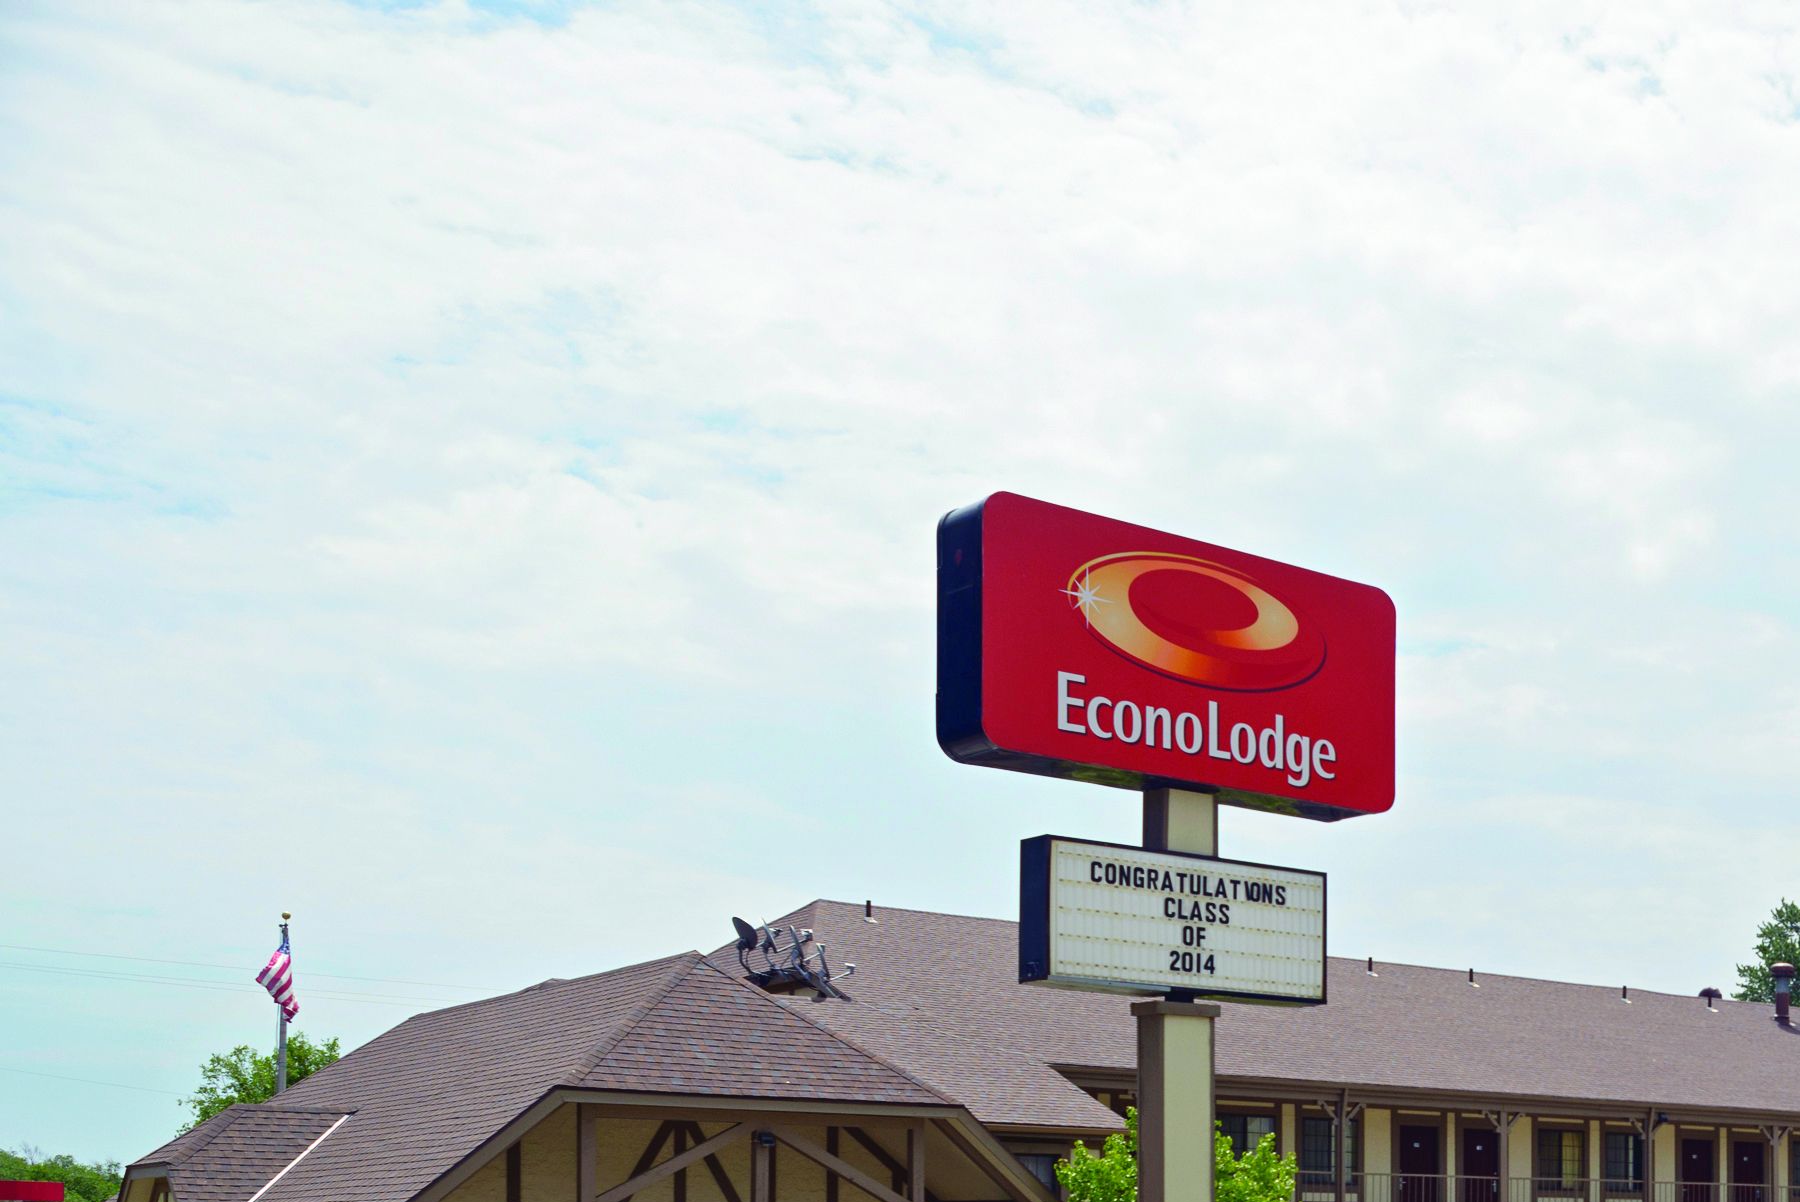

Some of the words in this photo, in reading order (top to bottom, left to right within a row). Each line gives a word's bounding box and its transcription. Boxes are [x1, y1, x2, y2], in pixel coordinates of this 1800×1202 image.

[1057, 670, 1336, 787] EconoLodge
[1090, 861, 1287, 906] CONGRATULATIONS
[1163, 896, 1230, 925] CLASS
[1182, 925, 1207, 947] OF
[1169, 950, 1216, 975] 2014
